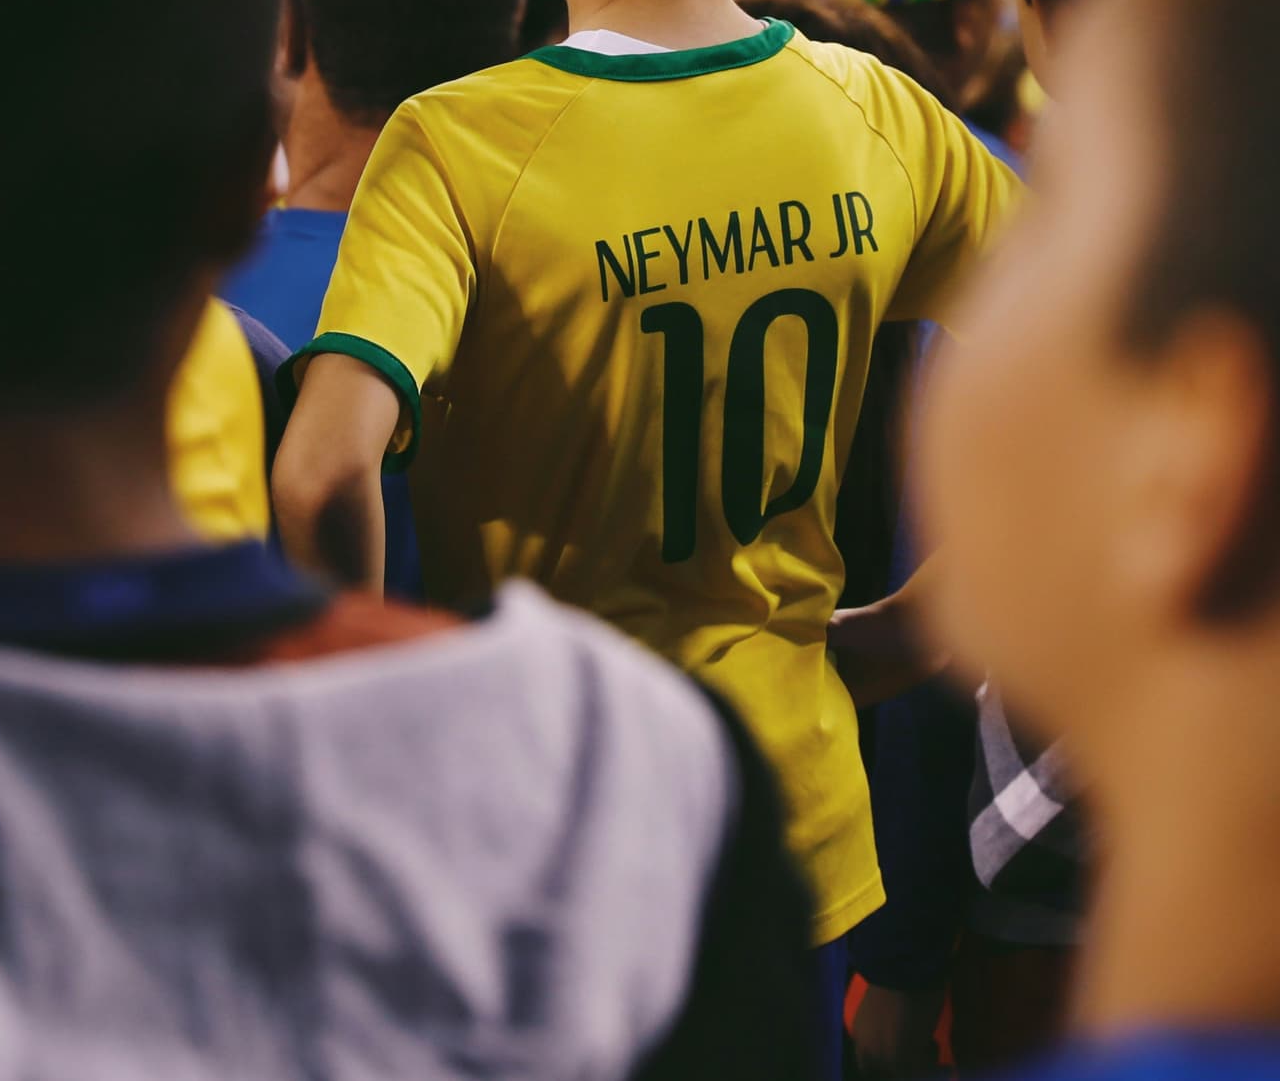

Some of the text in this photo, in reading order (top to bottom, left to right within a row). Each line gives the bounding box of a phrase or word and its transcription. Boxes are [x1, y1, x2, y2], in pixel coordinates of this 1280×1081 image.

[595, 191, 879, 302] NEYMAR JR
[640, 288, 839, 564] 10
